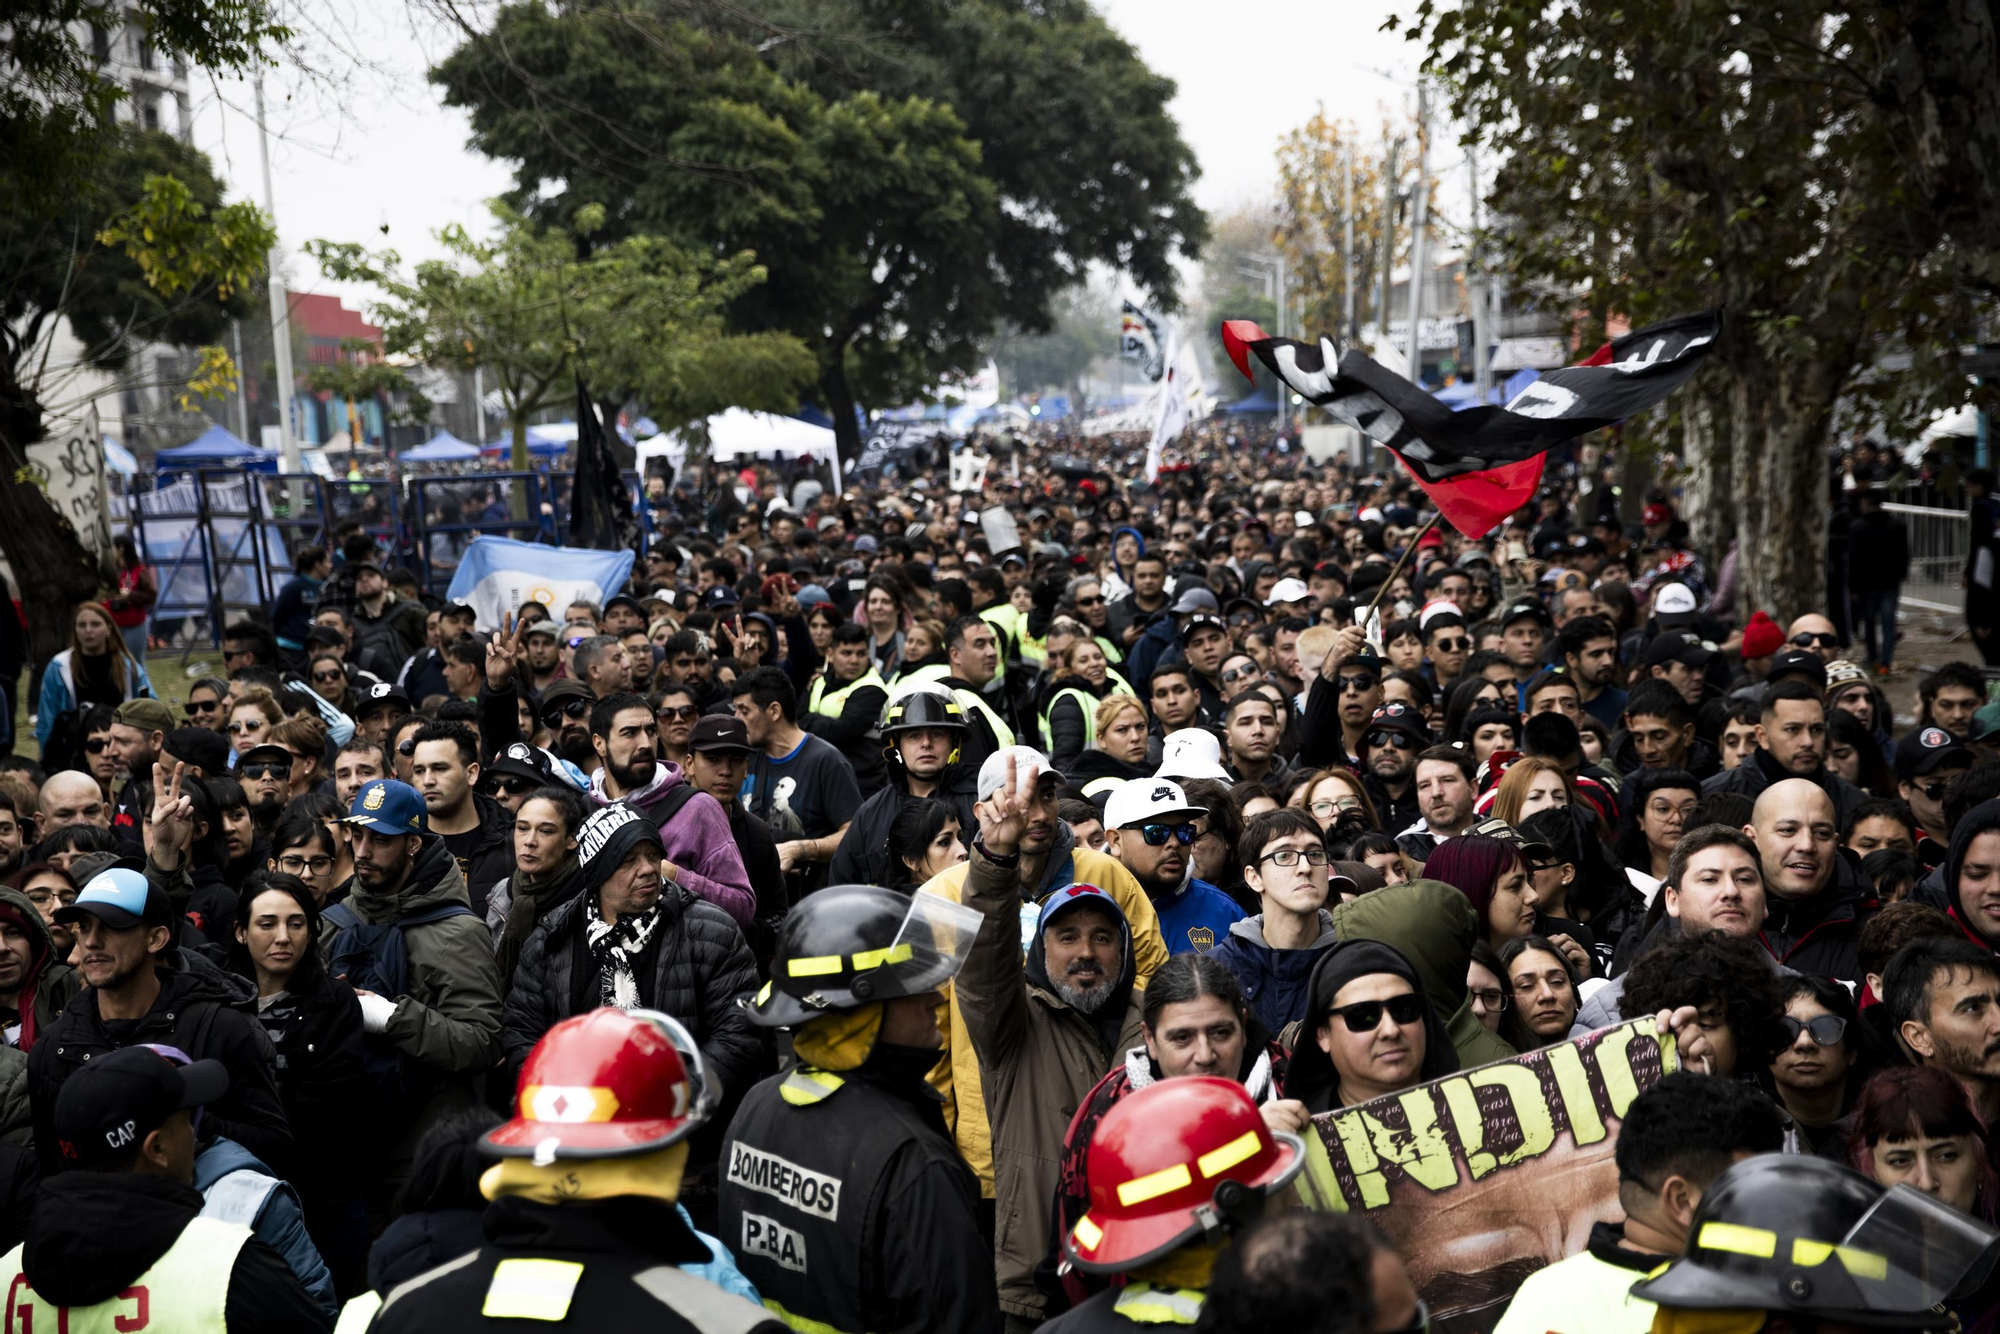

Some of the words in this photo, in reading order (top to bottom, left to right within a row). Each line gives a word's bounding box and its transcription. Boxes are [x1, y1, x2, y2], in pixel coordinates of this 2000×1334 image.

[1154, 786, 1171, 795] NIKE
[106, 1120, 136, 1148] CAP
[731, 1148, 836, 1213] BOMBEROS
